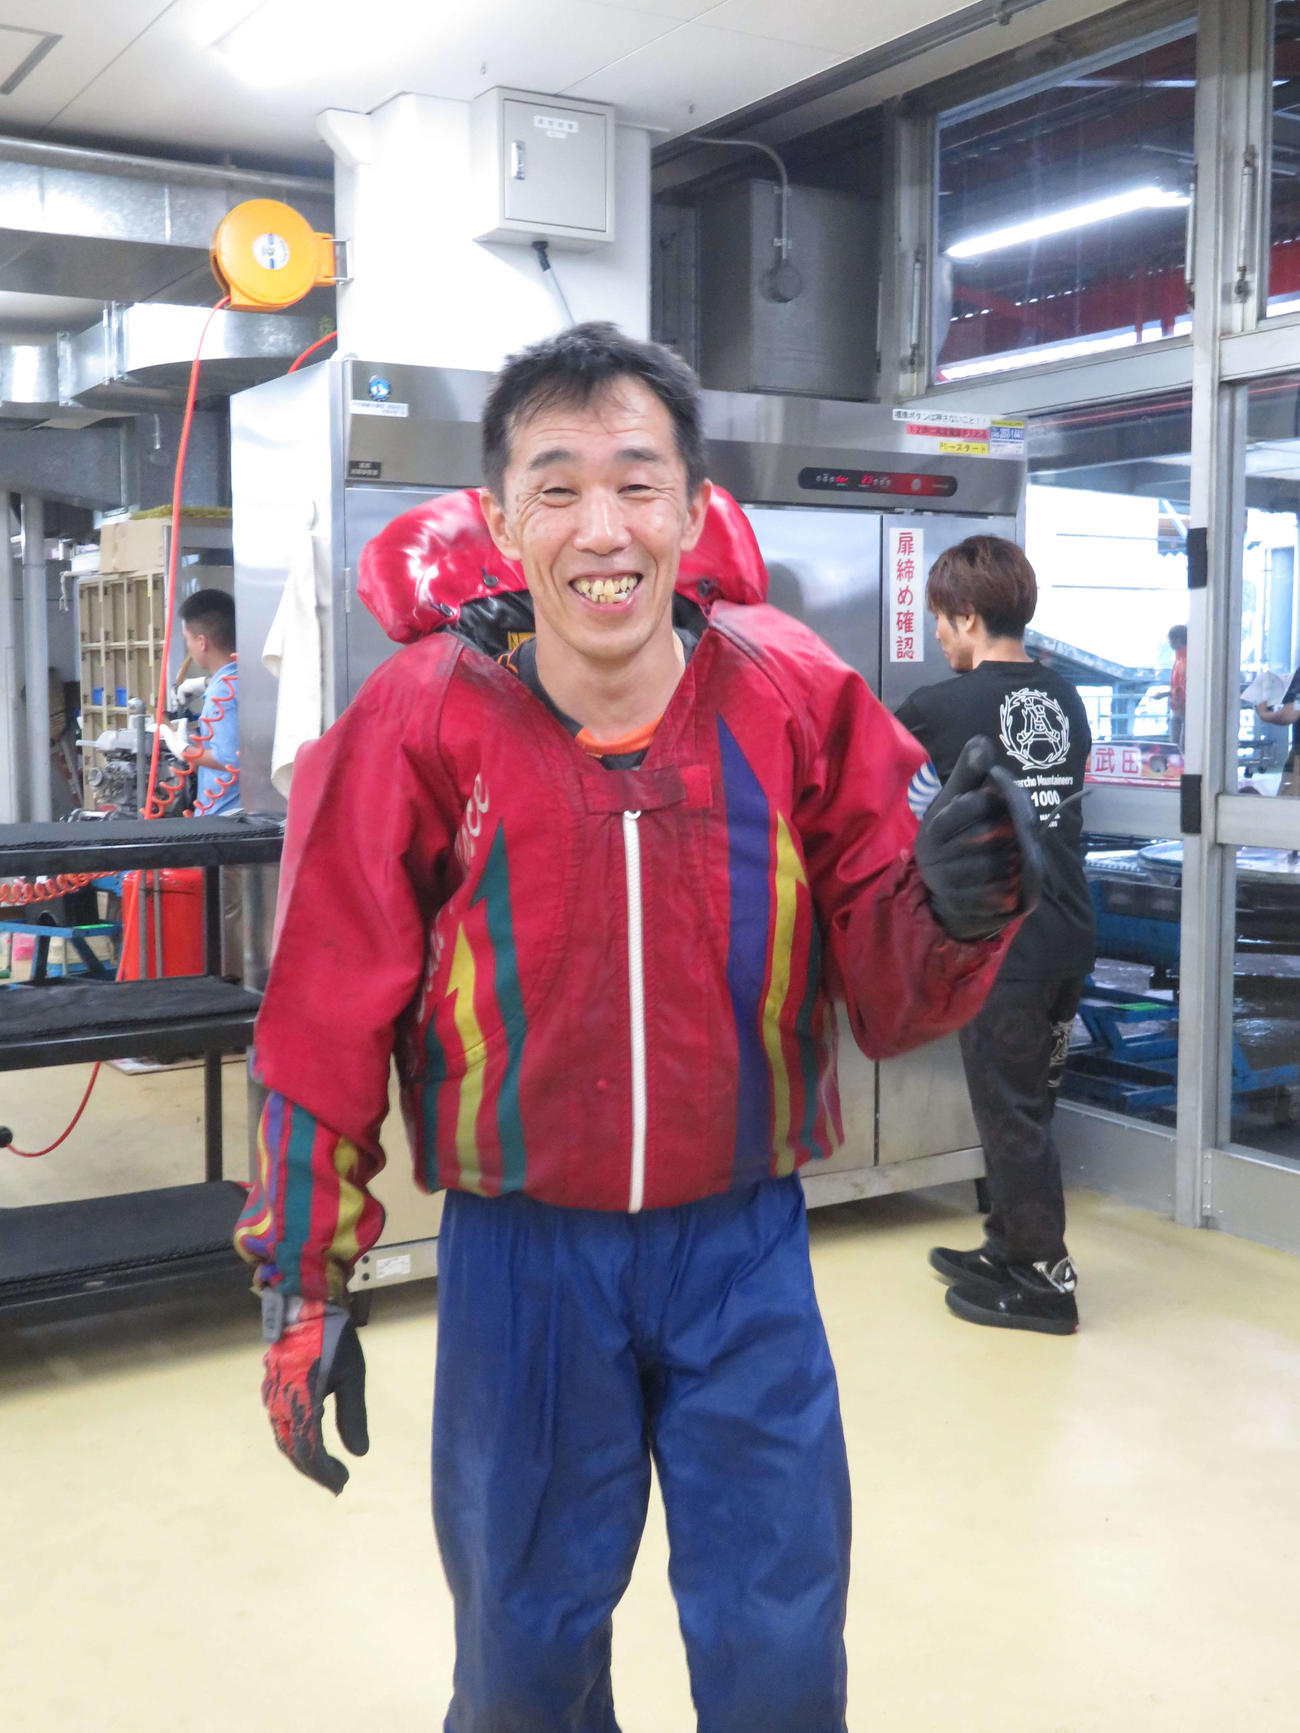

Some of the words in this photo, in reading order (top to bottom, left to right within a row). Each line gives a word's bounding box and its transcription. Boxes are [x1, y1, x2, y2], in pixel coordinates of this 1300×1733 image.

[896, 531, 915, 660] 扉締め確認
[1095, 747, 1139, 774] 武田
[1031, 790, 1060, 807] 1000
